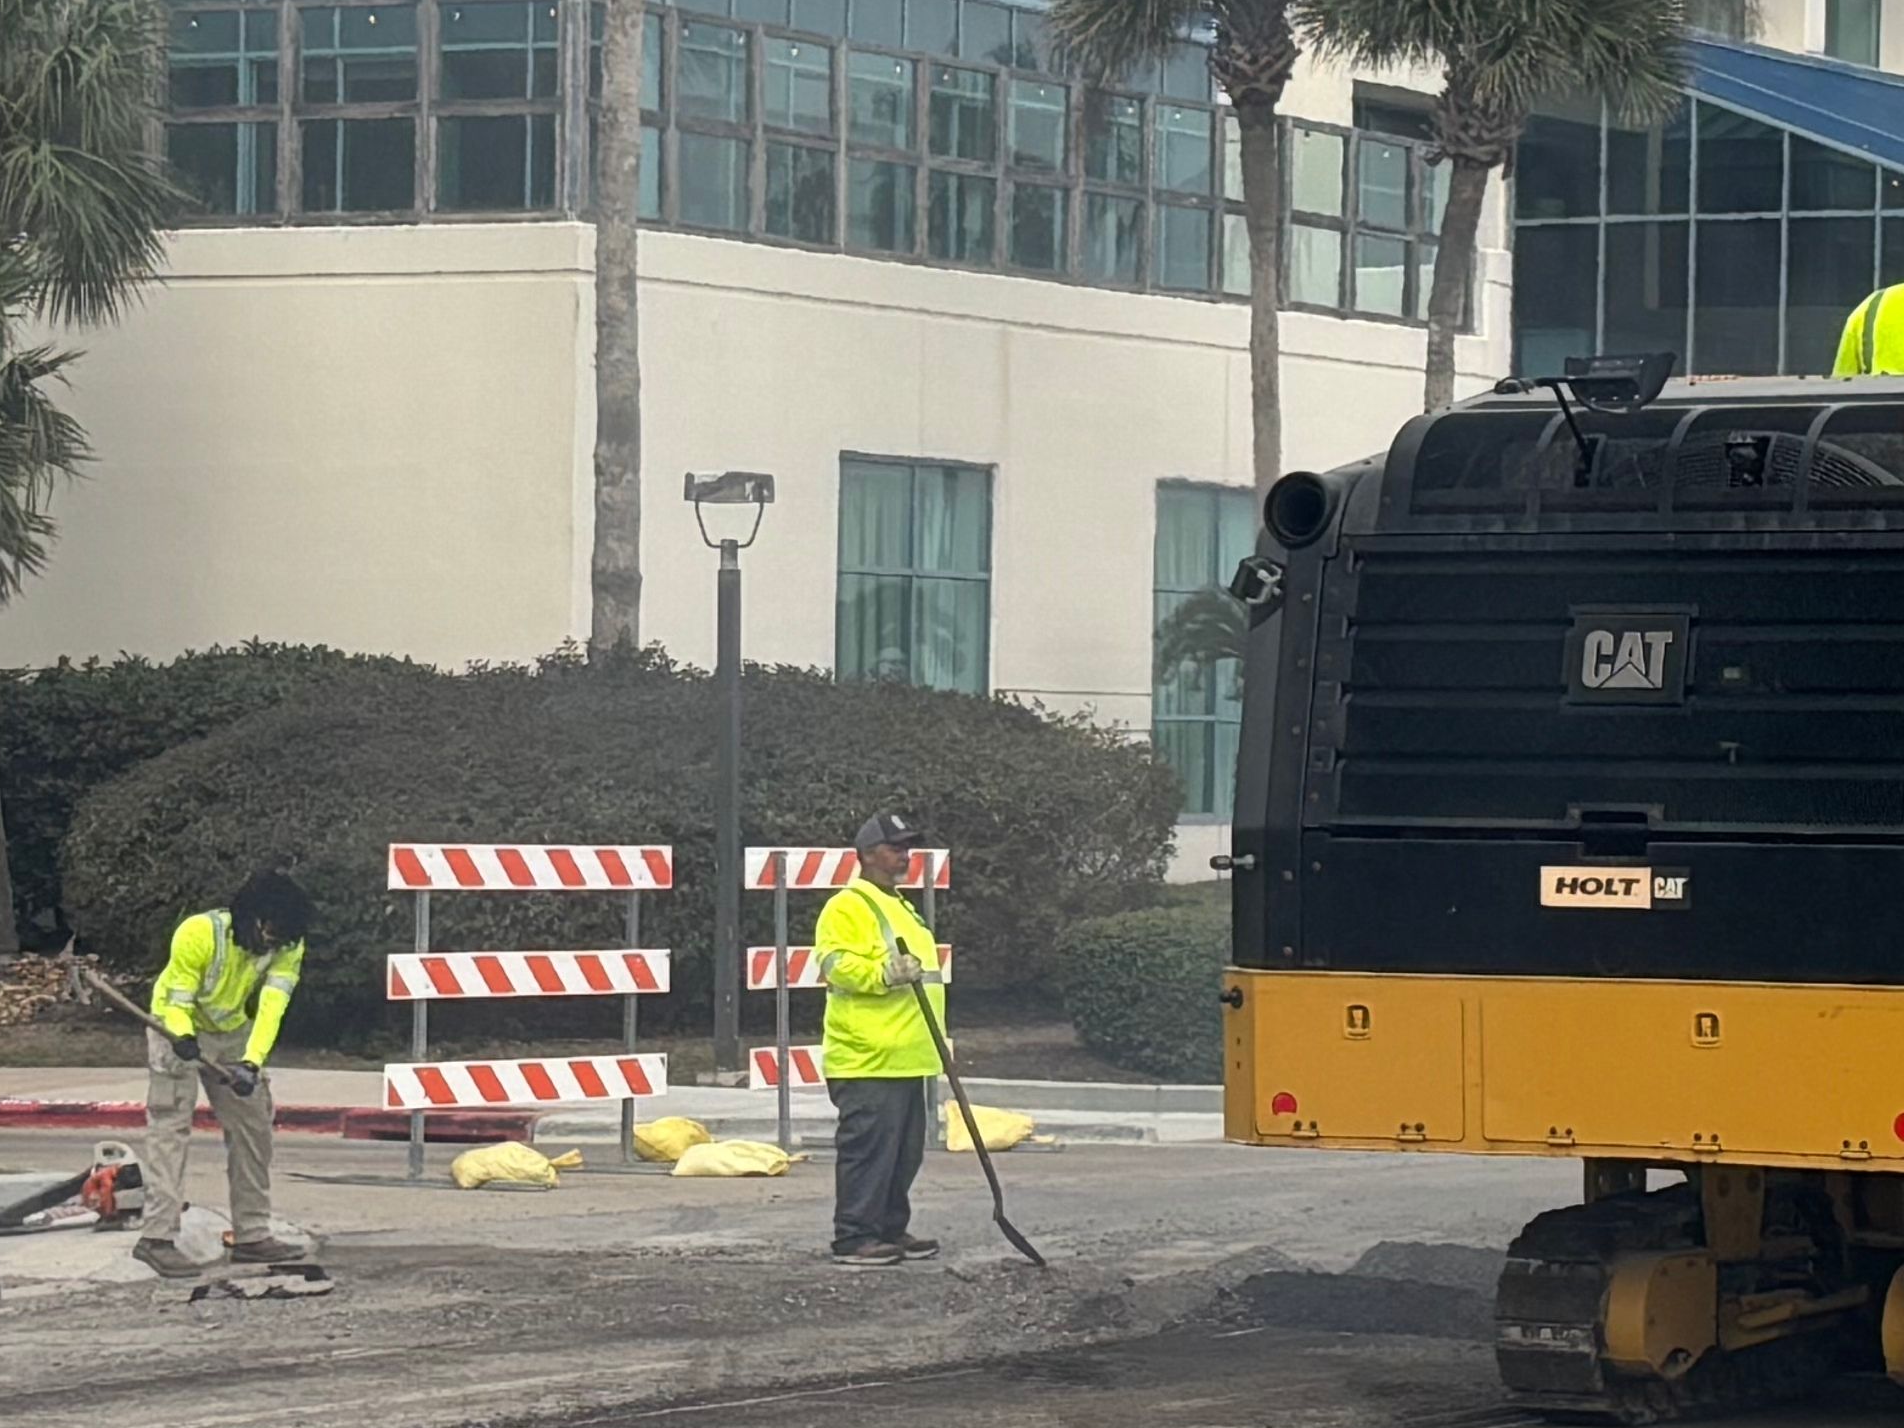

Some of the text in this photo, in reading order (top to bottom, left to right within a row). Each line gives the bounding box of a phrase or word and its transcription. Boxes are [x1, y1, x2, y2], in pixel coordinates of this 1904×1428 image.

[1582, 629, 1673, 689] CAT
[1555, 876, 1689, 899] HOLT CAT
